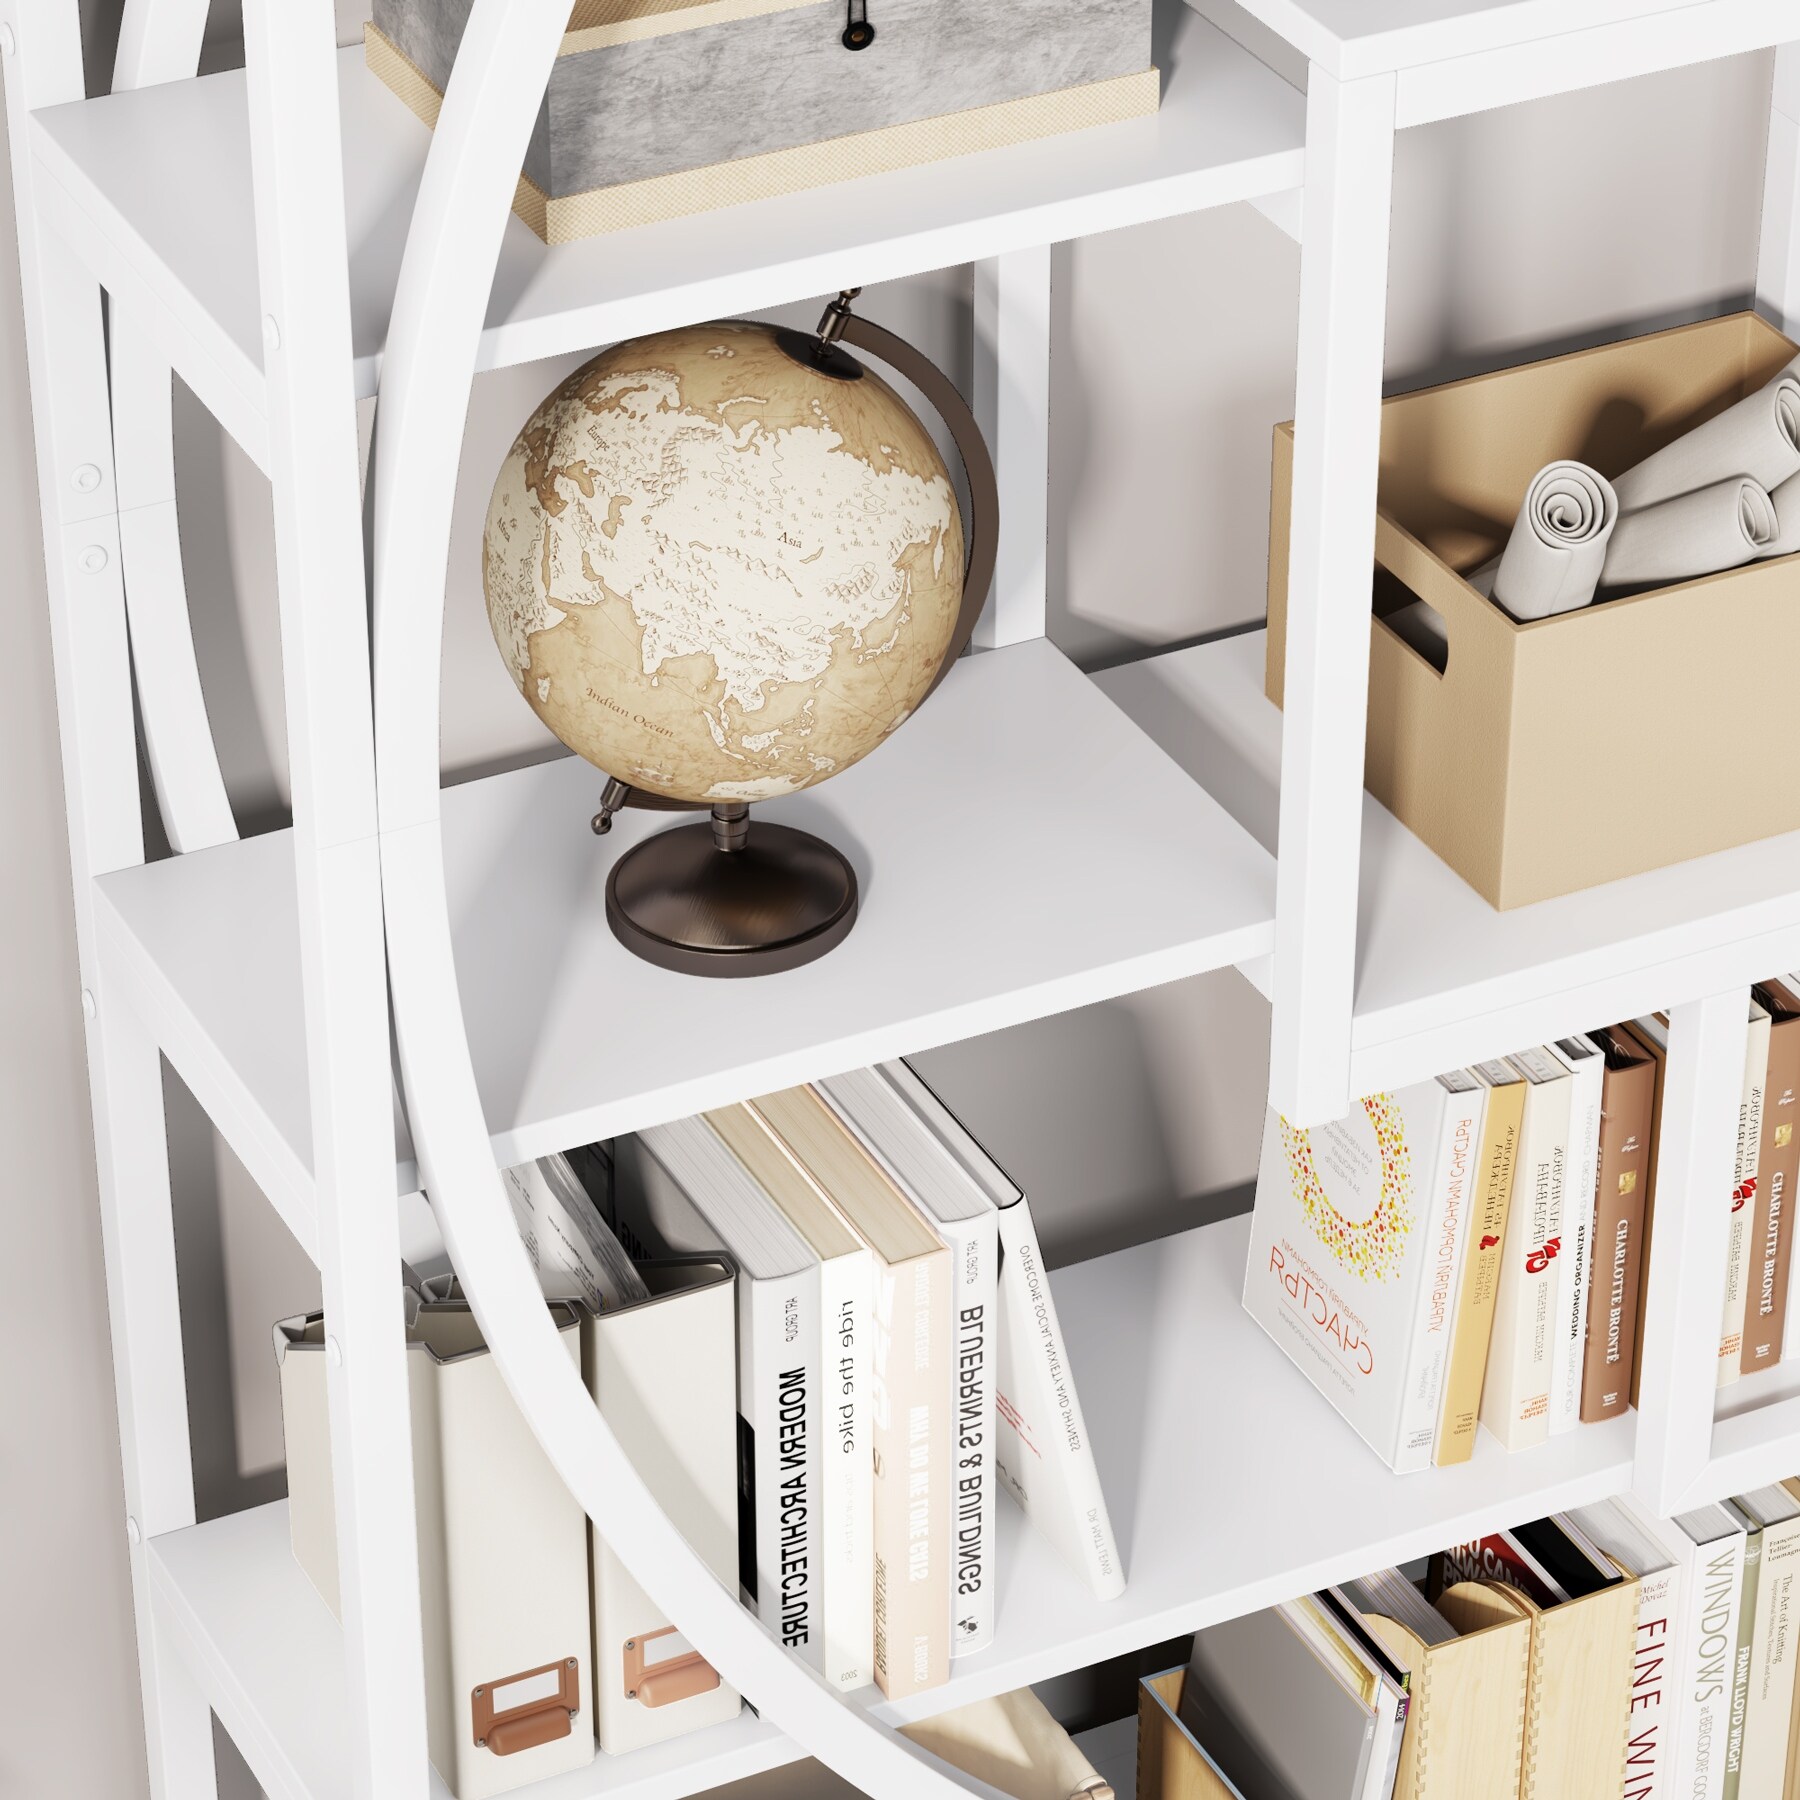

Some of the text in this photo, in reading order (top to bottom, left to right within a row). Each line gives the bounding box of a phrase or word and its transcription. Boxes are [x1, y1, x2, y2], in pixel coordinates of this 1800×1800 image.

[587, 423, 611, 452] Europe
[776, 530, 803, 550] Asia
[585, 686, 675, 739] Indian Ocean
[1574, 1224, 1586, 1287] ORGANIZER
[1759, 1171, 1784, 1316] CHARLOTTE BRONTË
[1570, 1288, 1581, 1341] WEDDING
[1606, 1219, 1629, 1364] CHARLOTTE BRONTË
[1640, 1578, 1669, 1595] Michel
[1780, 1596, 1790, 1614] Art
[1782, 1573, 1793, 1593] The
[1695, 1546, 1736, 1703] WINDOWS
[1772, 1624, 1788, 1664] Knitting
[1630, 1618, 1667, 1714] FINE
[1727, 1645, 1750, 1773] FRANK LLOYD WRIGHT
[1695, 1715, 1713, 1773] BERGDORF
